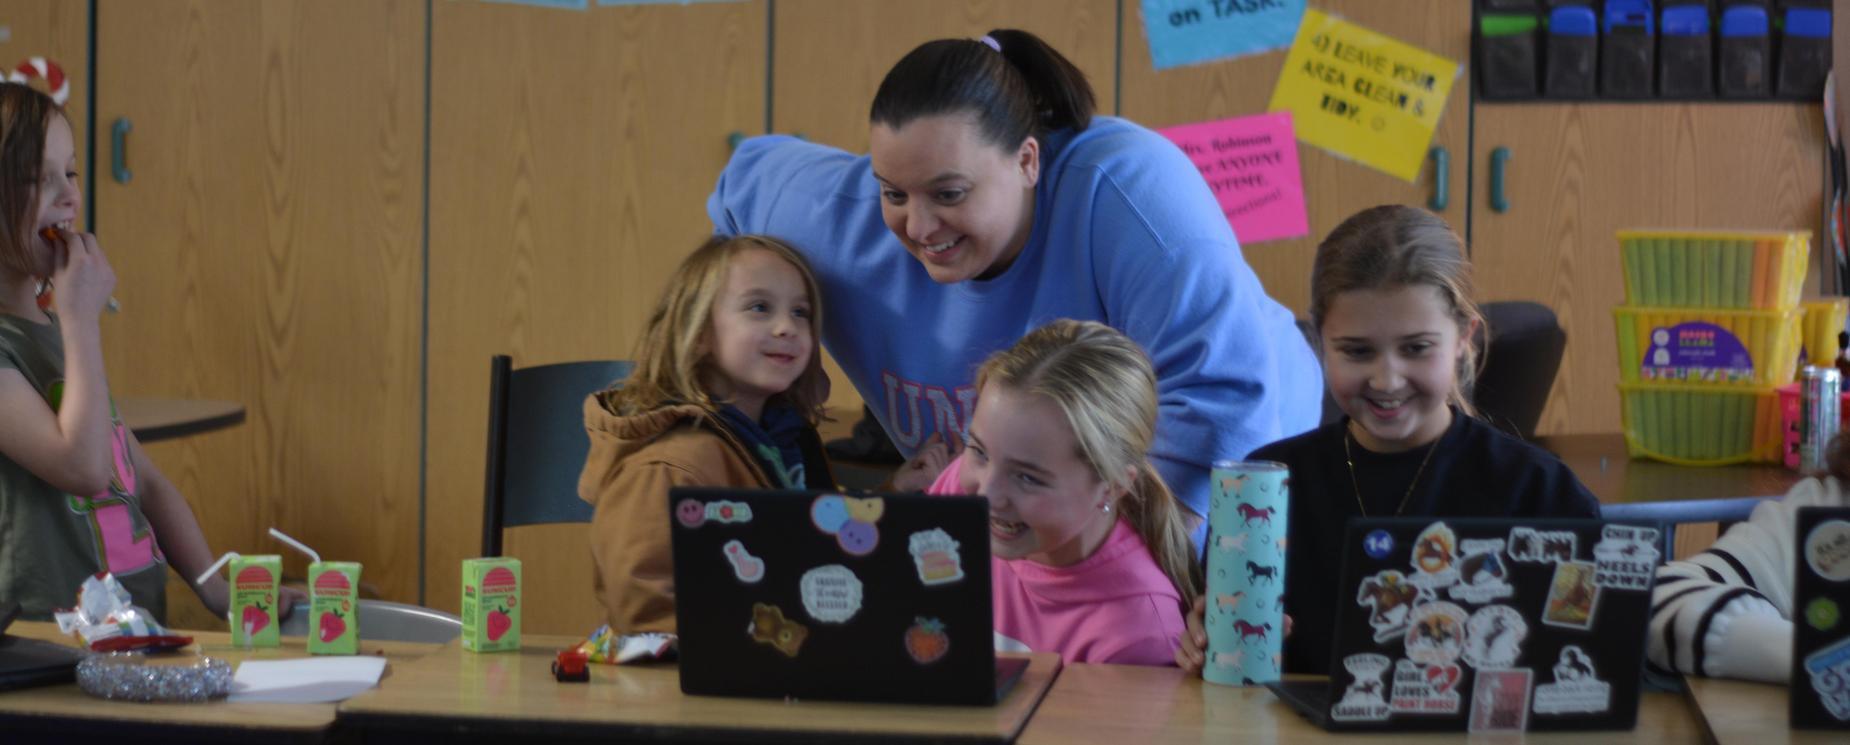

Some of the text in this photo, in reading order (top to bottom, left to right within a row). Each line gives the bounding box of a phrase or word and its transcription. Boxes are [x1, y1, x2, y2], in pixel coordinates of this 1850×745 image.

[1168, 8, 1202, 27] on
[1334, 41, 1387, 74] LEAVE
[1392, 61, 1436, 93] YOUR
[1303, 59, 1347, 88] AREA
[1353, 77, 1407, 110] CLEAN
[1211, 135, 1272, 152] Robinson
[1605, 528, 1635, 540] CHIN
[1368, 537, 1391, 548] 14
[1597, 560, 1650, 574] HEELS
[1596, 572, 1648, 586] DOWN
